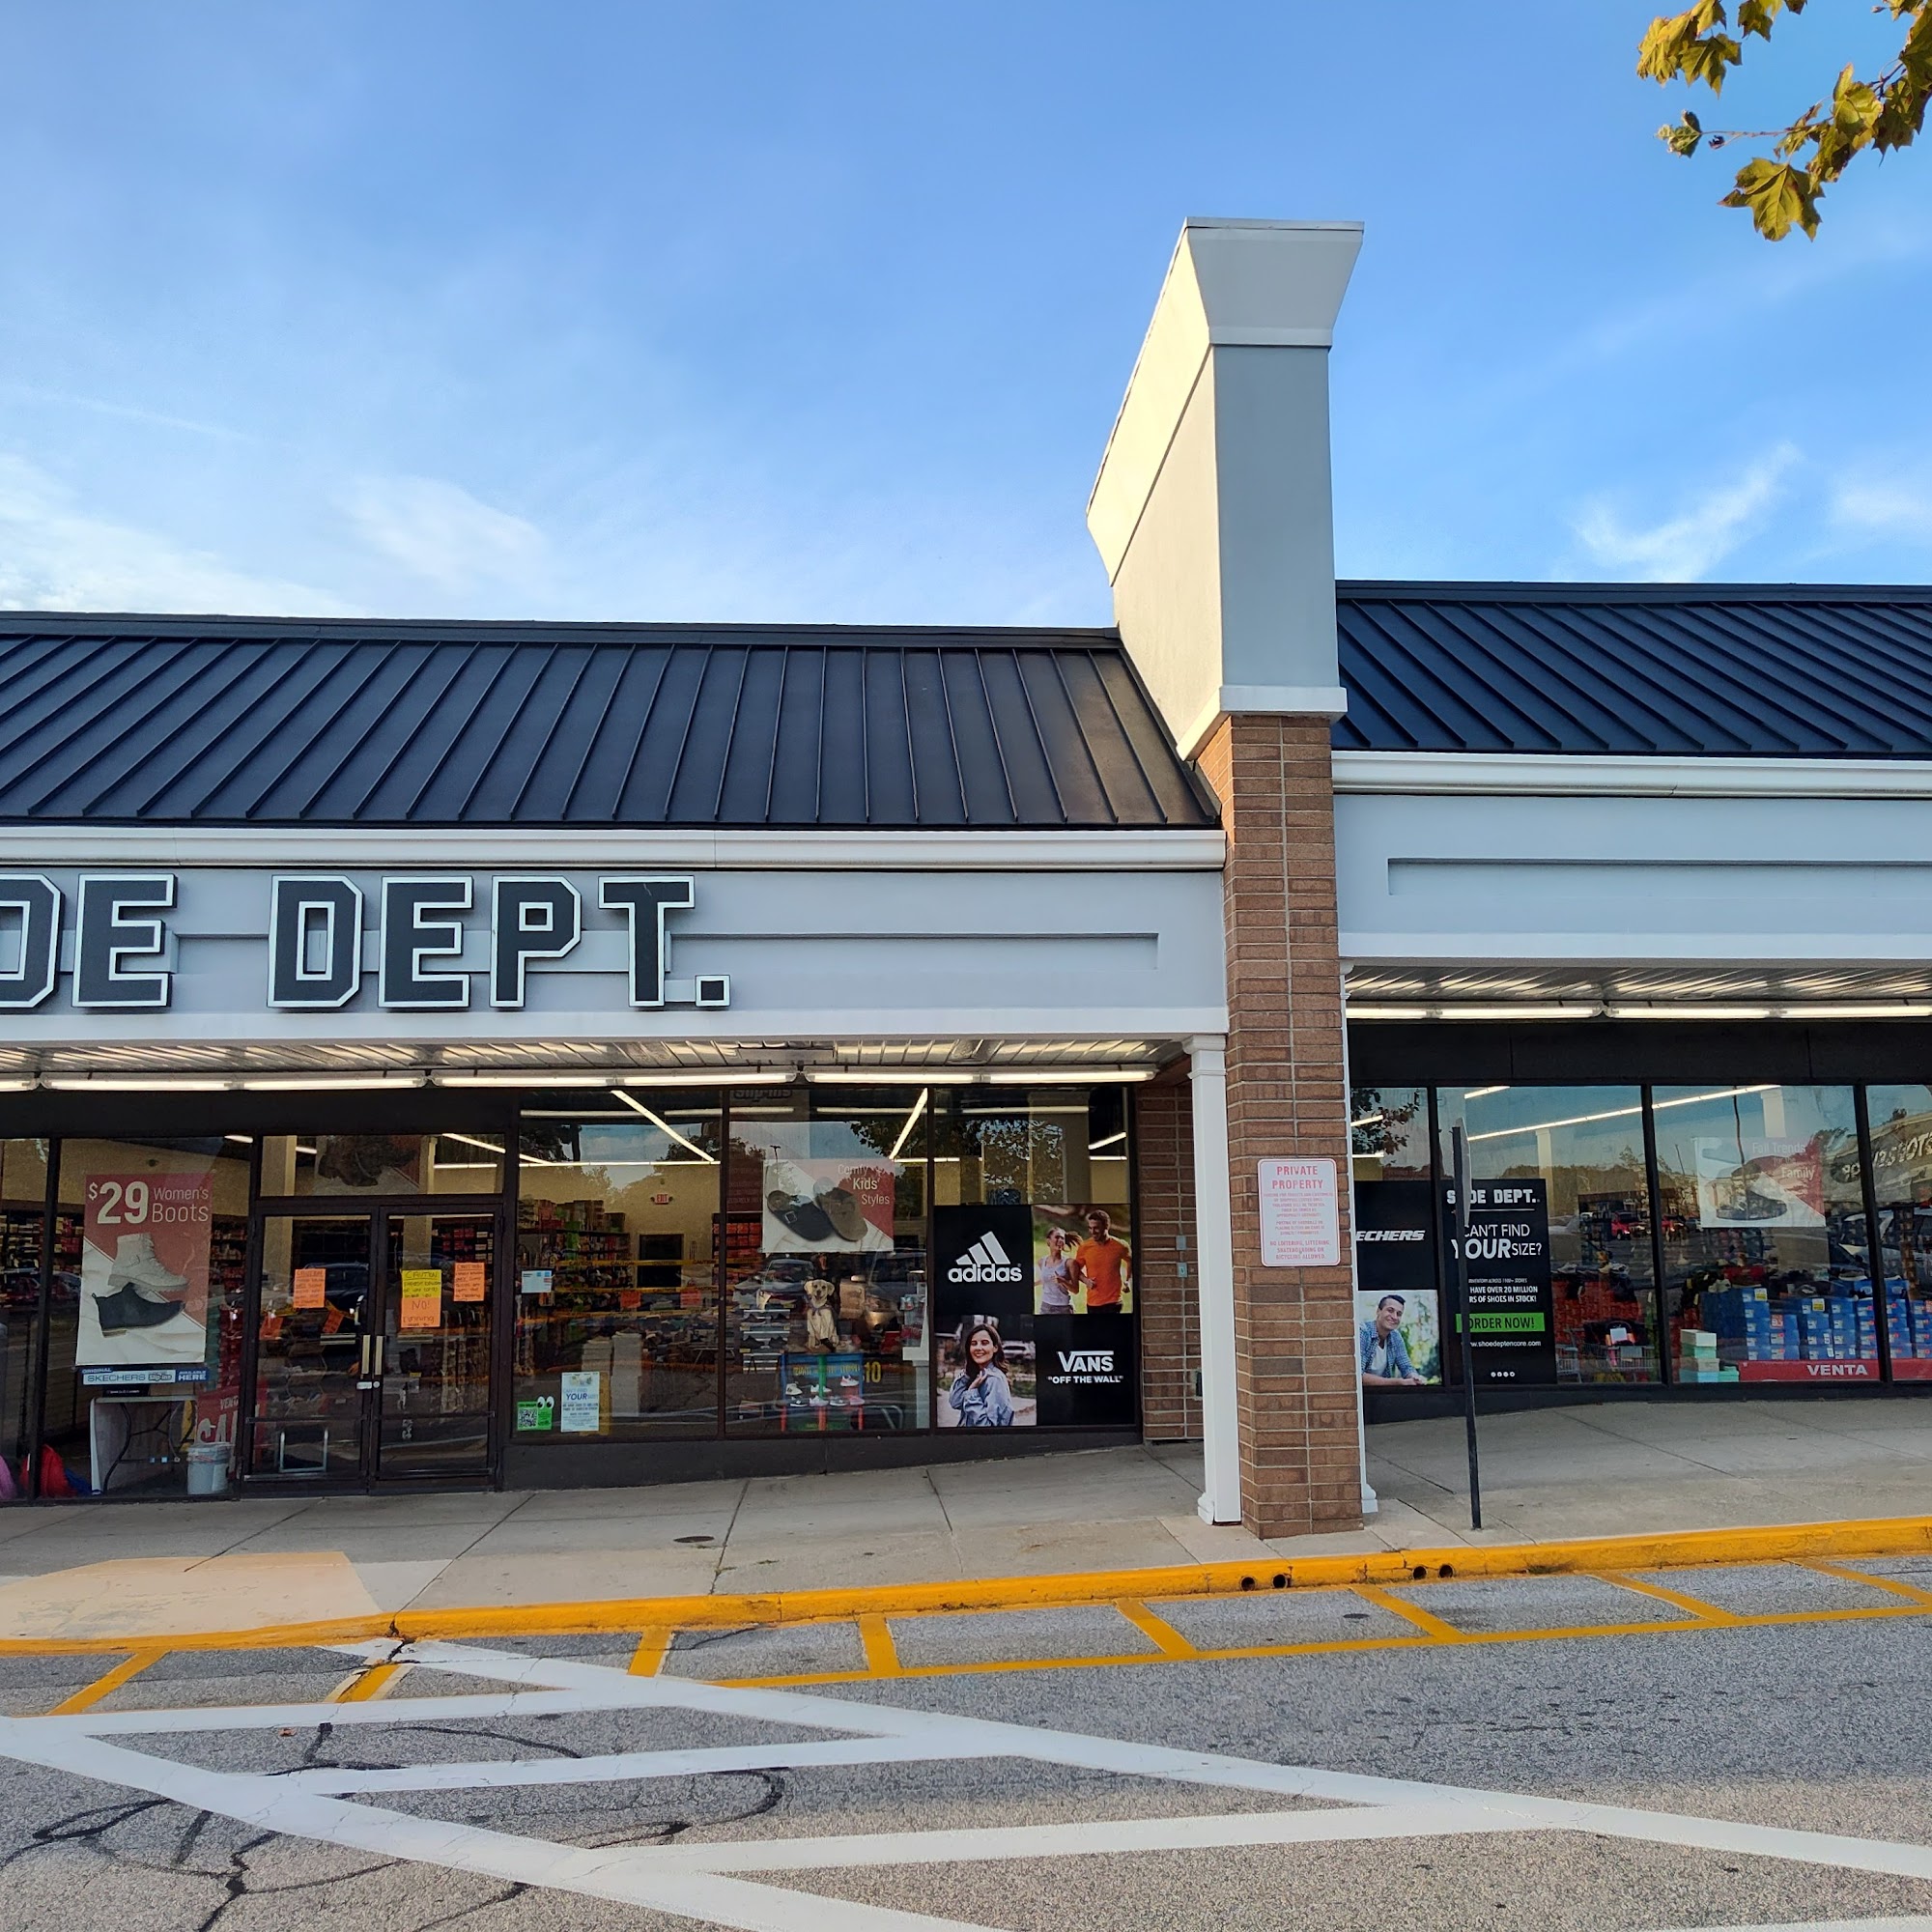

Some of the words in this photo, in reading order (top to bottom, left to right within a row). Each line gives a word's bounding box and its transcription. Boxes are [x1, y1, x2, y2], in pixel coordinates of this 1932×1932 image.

[268, 875, 730, 1008] DEPT.
[1752, 1142, 1769, 1153] Fall
[1772, 1142, 1805, 1153] Trends
[1277, 1166, 1319, 1175] PRIVATE
[1781, 1167, 1814, 1180] Family
[853, 1178, 881, 1190] Kids'
[1272, 1179, 1323, 1189] PROPERTY
[154, 1186, 209, 1200] Women's
[1446, 1189, 1487, 1205] SOE
[1493, 1189, 1537, 1204] DEPT.
[89, 1180, 149, 1224] $29
[861, 1193, 890, 1207] Styles
[152, 1203, 209, 1223] Boots
[1356, 1230, 1426, 1241] ECHERS
[1501, 1224, 1530, 1236] FIND
[1511, 1242, 1543, 1256] SIZE?
[948, 1264, 1023, 1283] adidas
[1468, 1318, 1502, 1329] ORDER
[1504, 1317, 1535, 1328] NOW!
[1057, 1350, 1115, 1373] VANS
[1806, 1364, 1868, 1376] VENTA
[566, 1392, 588, 1401] YOUR
